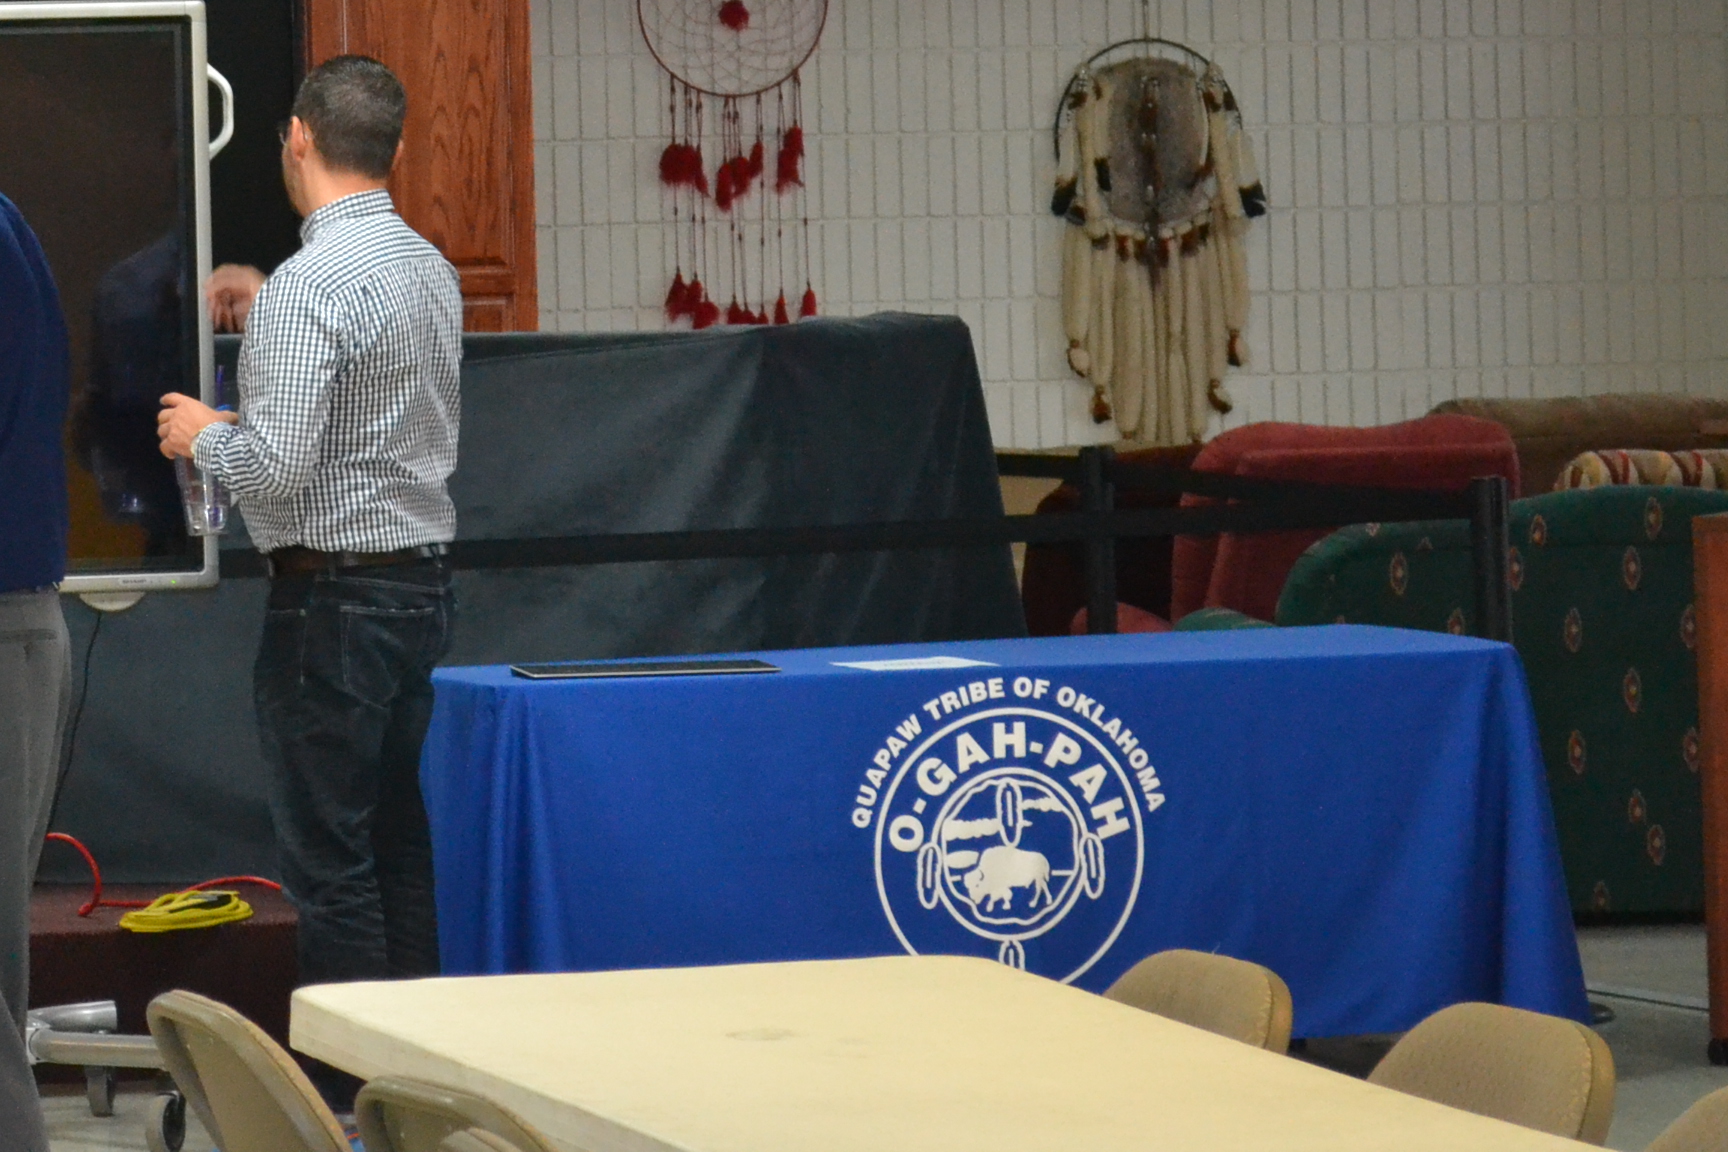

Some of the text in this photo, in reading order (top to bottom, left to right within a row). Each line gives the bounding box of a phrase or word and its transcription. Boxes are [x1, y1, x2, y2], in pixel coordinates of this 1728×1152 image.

[852, 677, 1166, 828] QUAPAW TRIBE OF OKLAHOMA
[889, 721, 1131, 852] O-GAH-PAH
